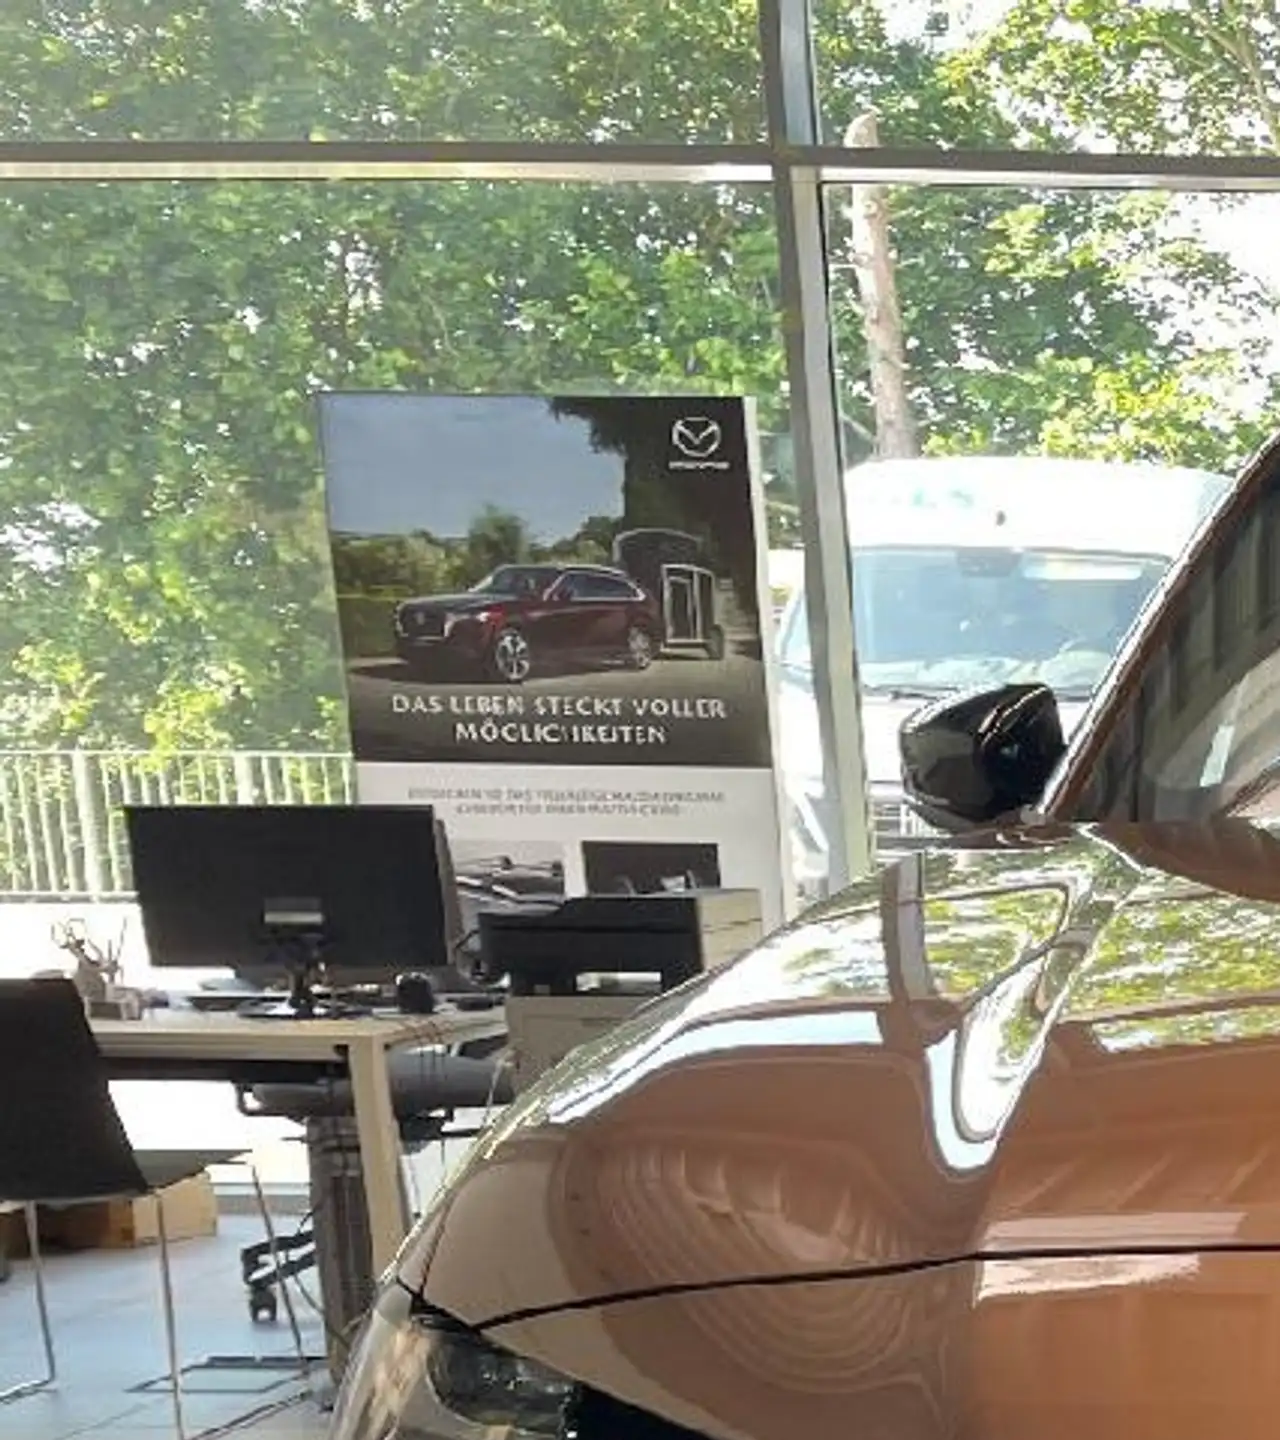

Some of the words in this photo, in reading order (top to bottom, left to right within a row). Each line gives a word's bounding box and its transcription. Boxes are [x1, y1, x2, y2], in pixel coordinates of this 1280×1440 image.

[391, 695, 443, 713] DAS
[449, 696, 524, 716] LEBEN
[534, 696, 624, 717] STECKT
[632, 698, 726, 719] VOLLER
